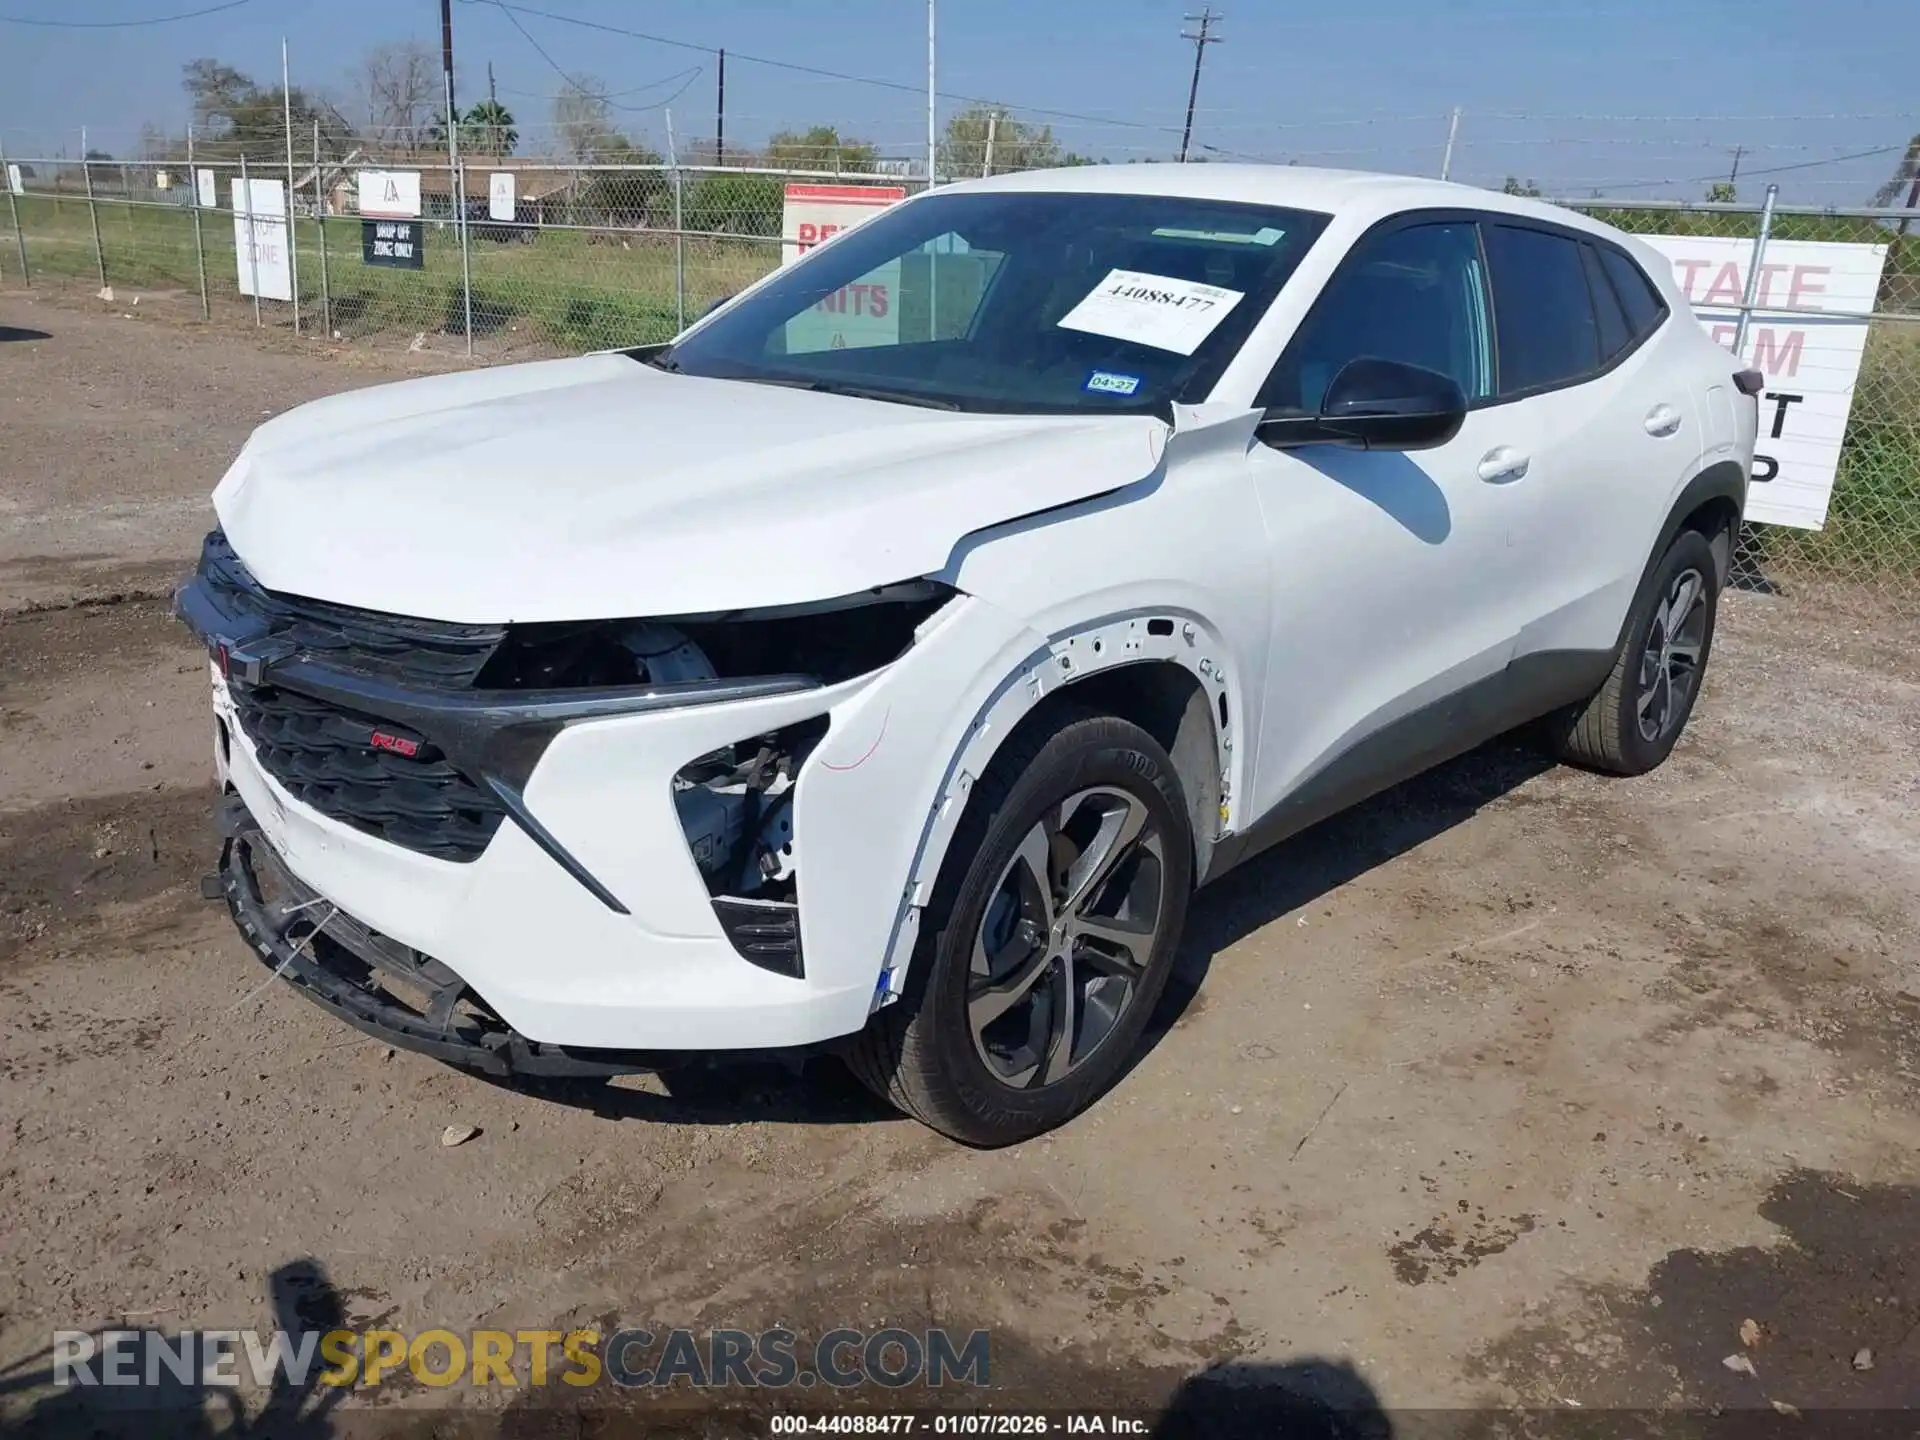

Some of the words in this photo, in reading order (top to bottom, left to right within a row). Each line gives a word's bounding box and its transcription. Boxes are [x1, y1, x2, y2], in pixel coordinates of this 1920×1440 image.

[394, 242, 413, 258] ONLY
[1108, 285, 1216, 312] 44088477
[371, 731, 419, 756] RS
